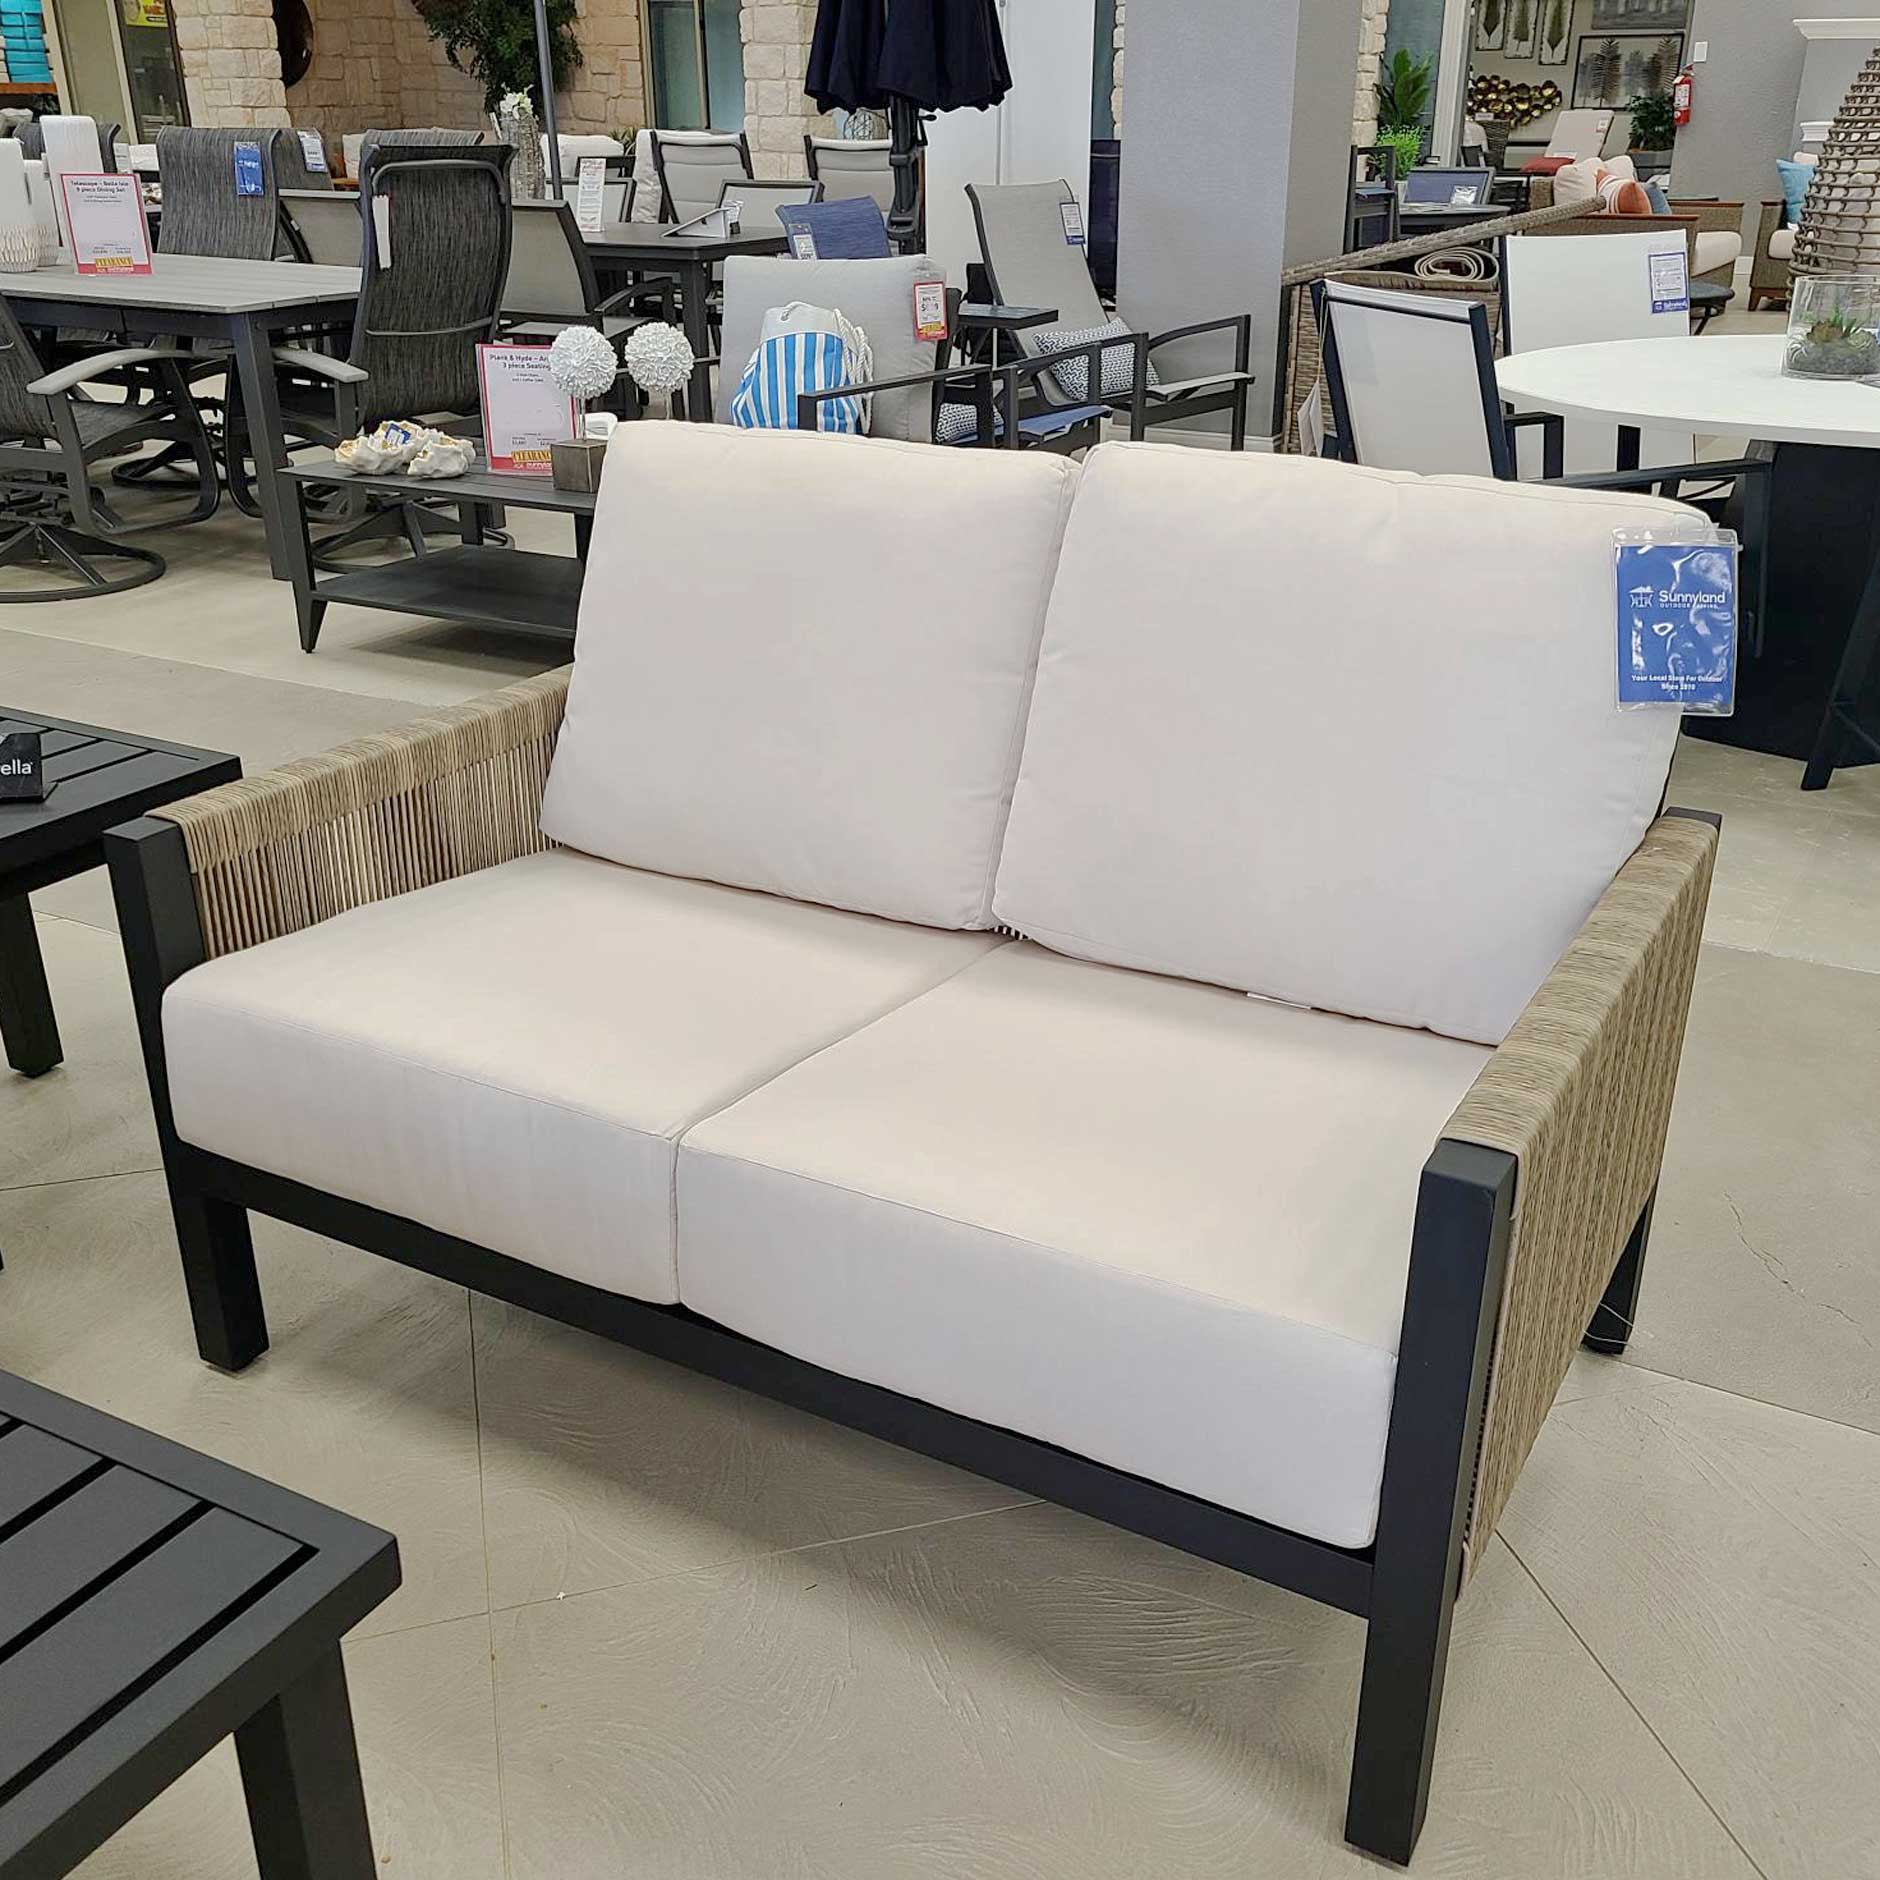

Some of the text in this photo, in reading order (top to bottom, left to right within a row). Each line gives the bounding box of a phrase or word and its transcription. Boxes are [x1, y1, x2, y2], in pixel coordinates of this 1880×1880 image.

[1658, 590, 1726, 606] Sunnyland
[1631, 674, 1648, 682] Your
[1649, 674, 1667, 682] Local
